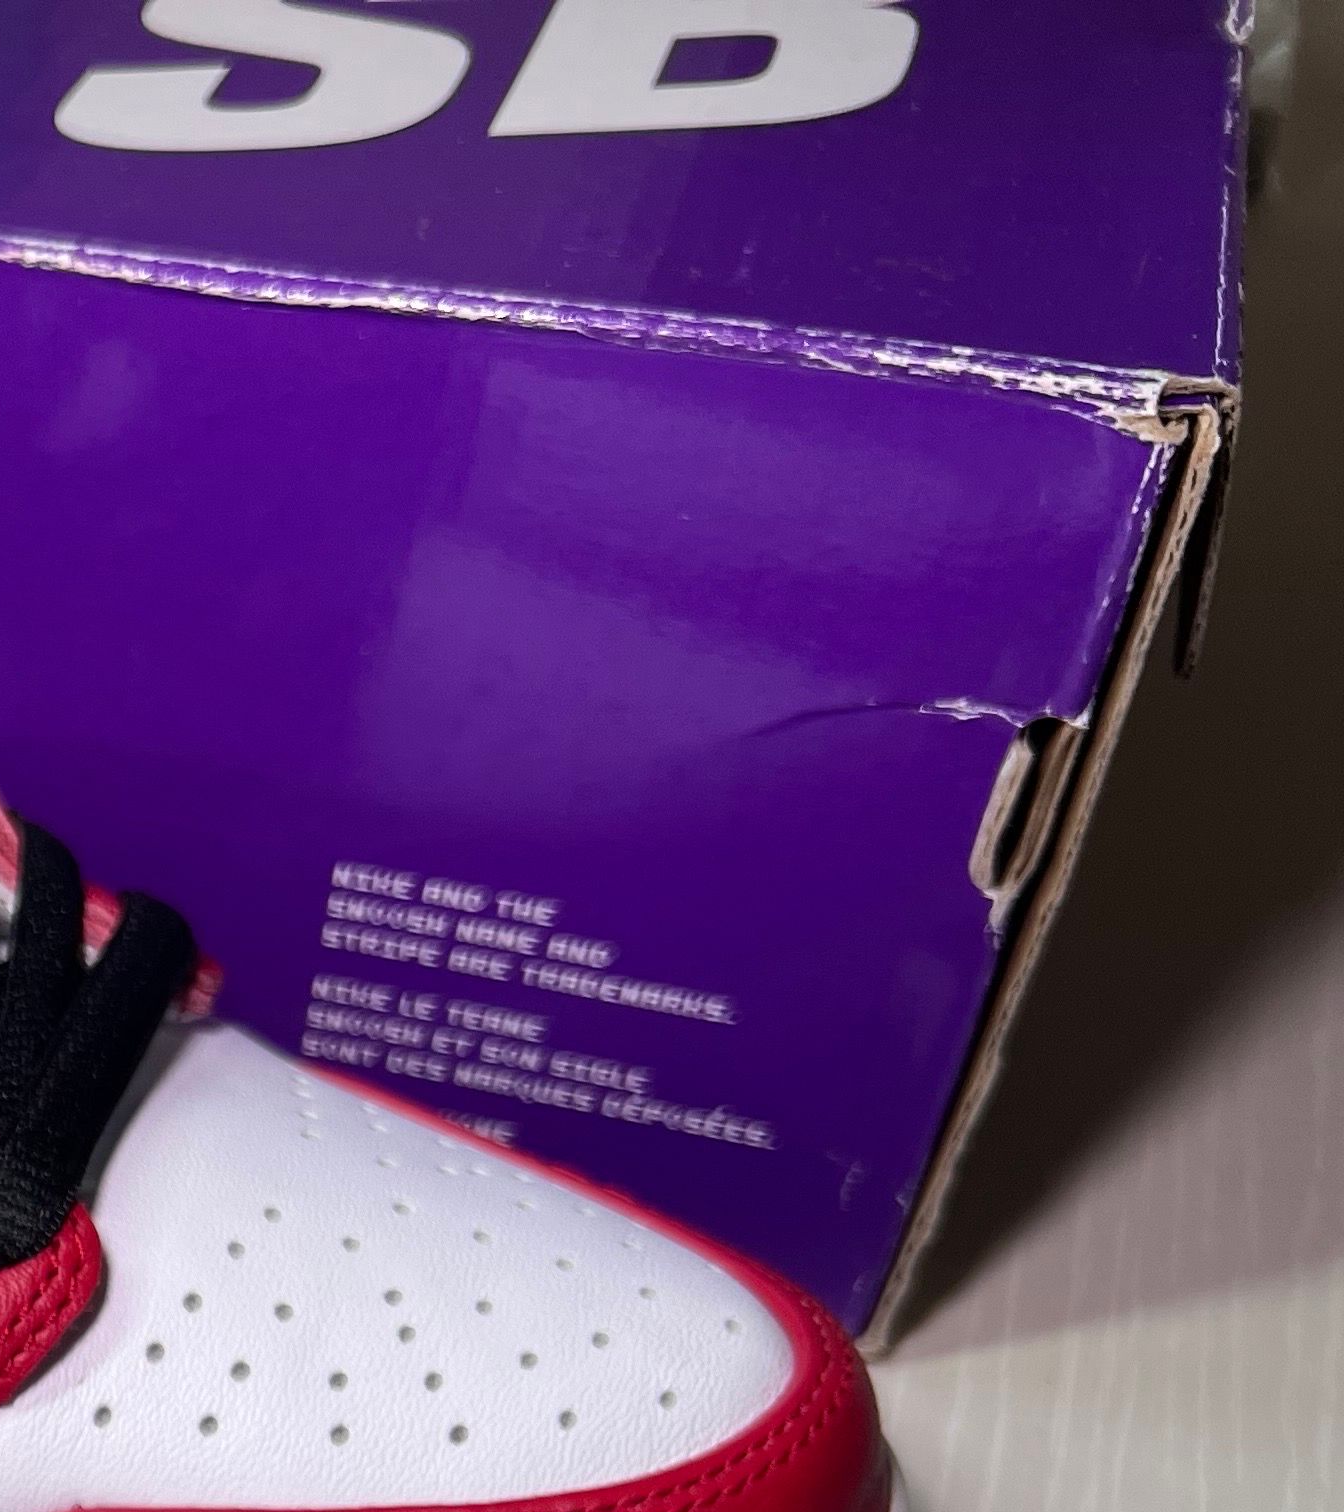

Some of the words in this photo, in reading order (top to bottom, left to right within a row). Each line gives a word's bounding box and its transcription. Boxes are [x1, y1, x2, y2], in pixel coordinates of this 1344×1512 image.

[332, 861, 420, 900] NIKE
[422, 877, 492, 912] AND
[495, 890, 563, 927] THE
[320, 920, 448, 967] STRIPE
[448, 945, 518, 981] ARE
[326, 890, 455, 938] SWOOSH
[454, 916, 545, 955] NAME
[546, 933, 621, 969] AND
[312, 973, 399, 1012] NIKE
[398, 990, 443, 1021] LE
[301, 1029, 386, 1068] SONT
[386, 1047, 454, 1082] DES
[306, 1001, 432, 1049] SWOOSH
[431, 1025, 479, 1057] ET
